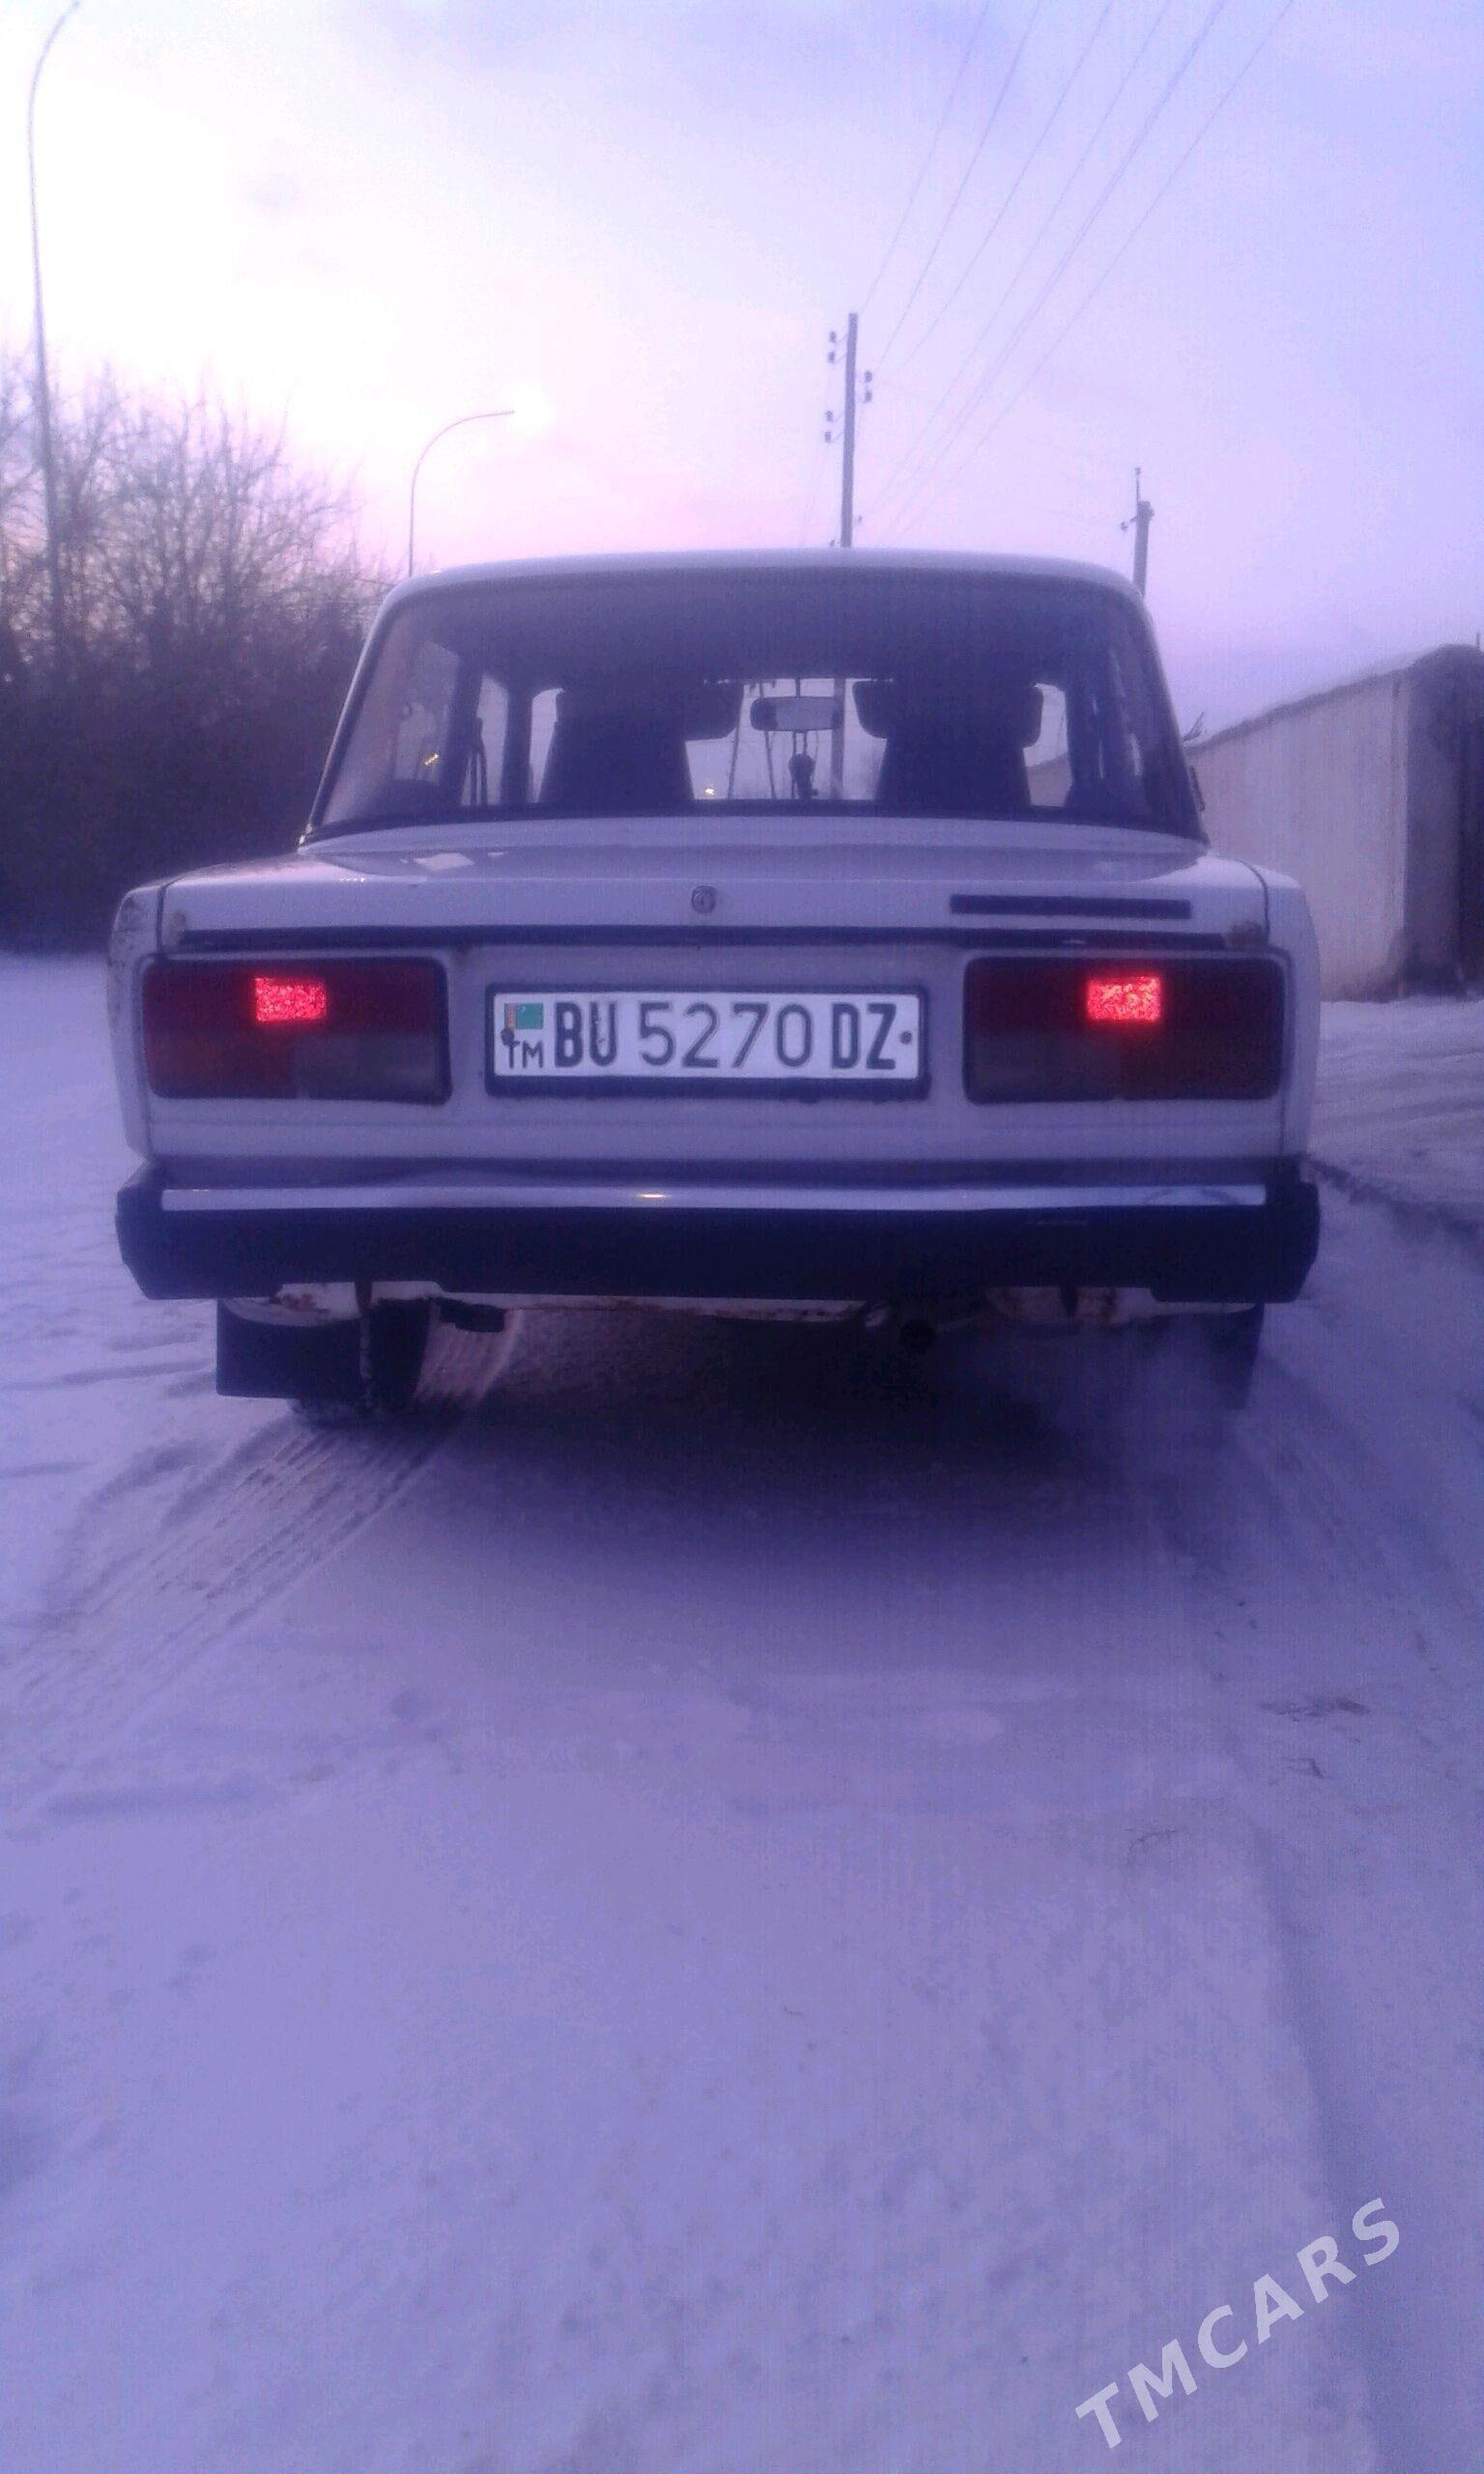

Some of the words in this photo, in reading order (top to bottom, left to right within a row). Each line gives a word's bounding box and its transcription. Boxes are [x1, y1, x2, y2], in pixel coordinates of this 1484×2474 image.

[554, 1001, 617, 1068] BU
[639, 1002, 813, 1068] 5270
[831, 1003, 897, 1070] DZ
